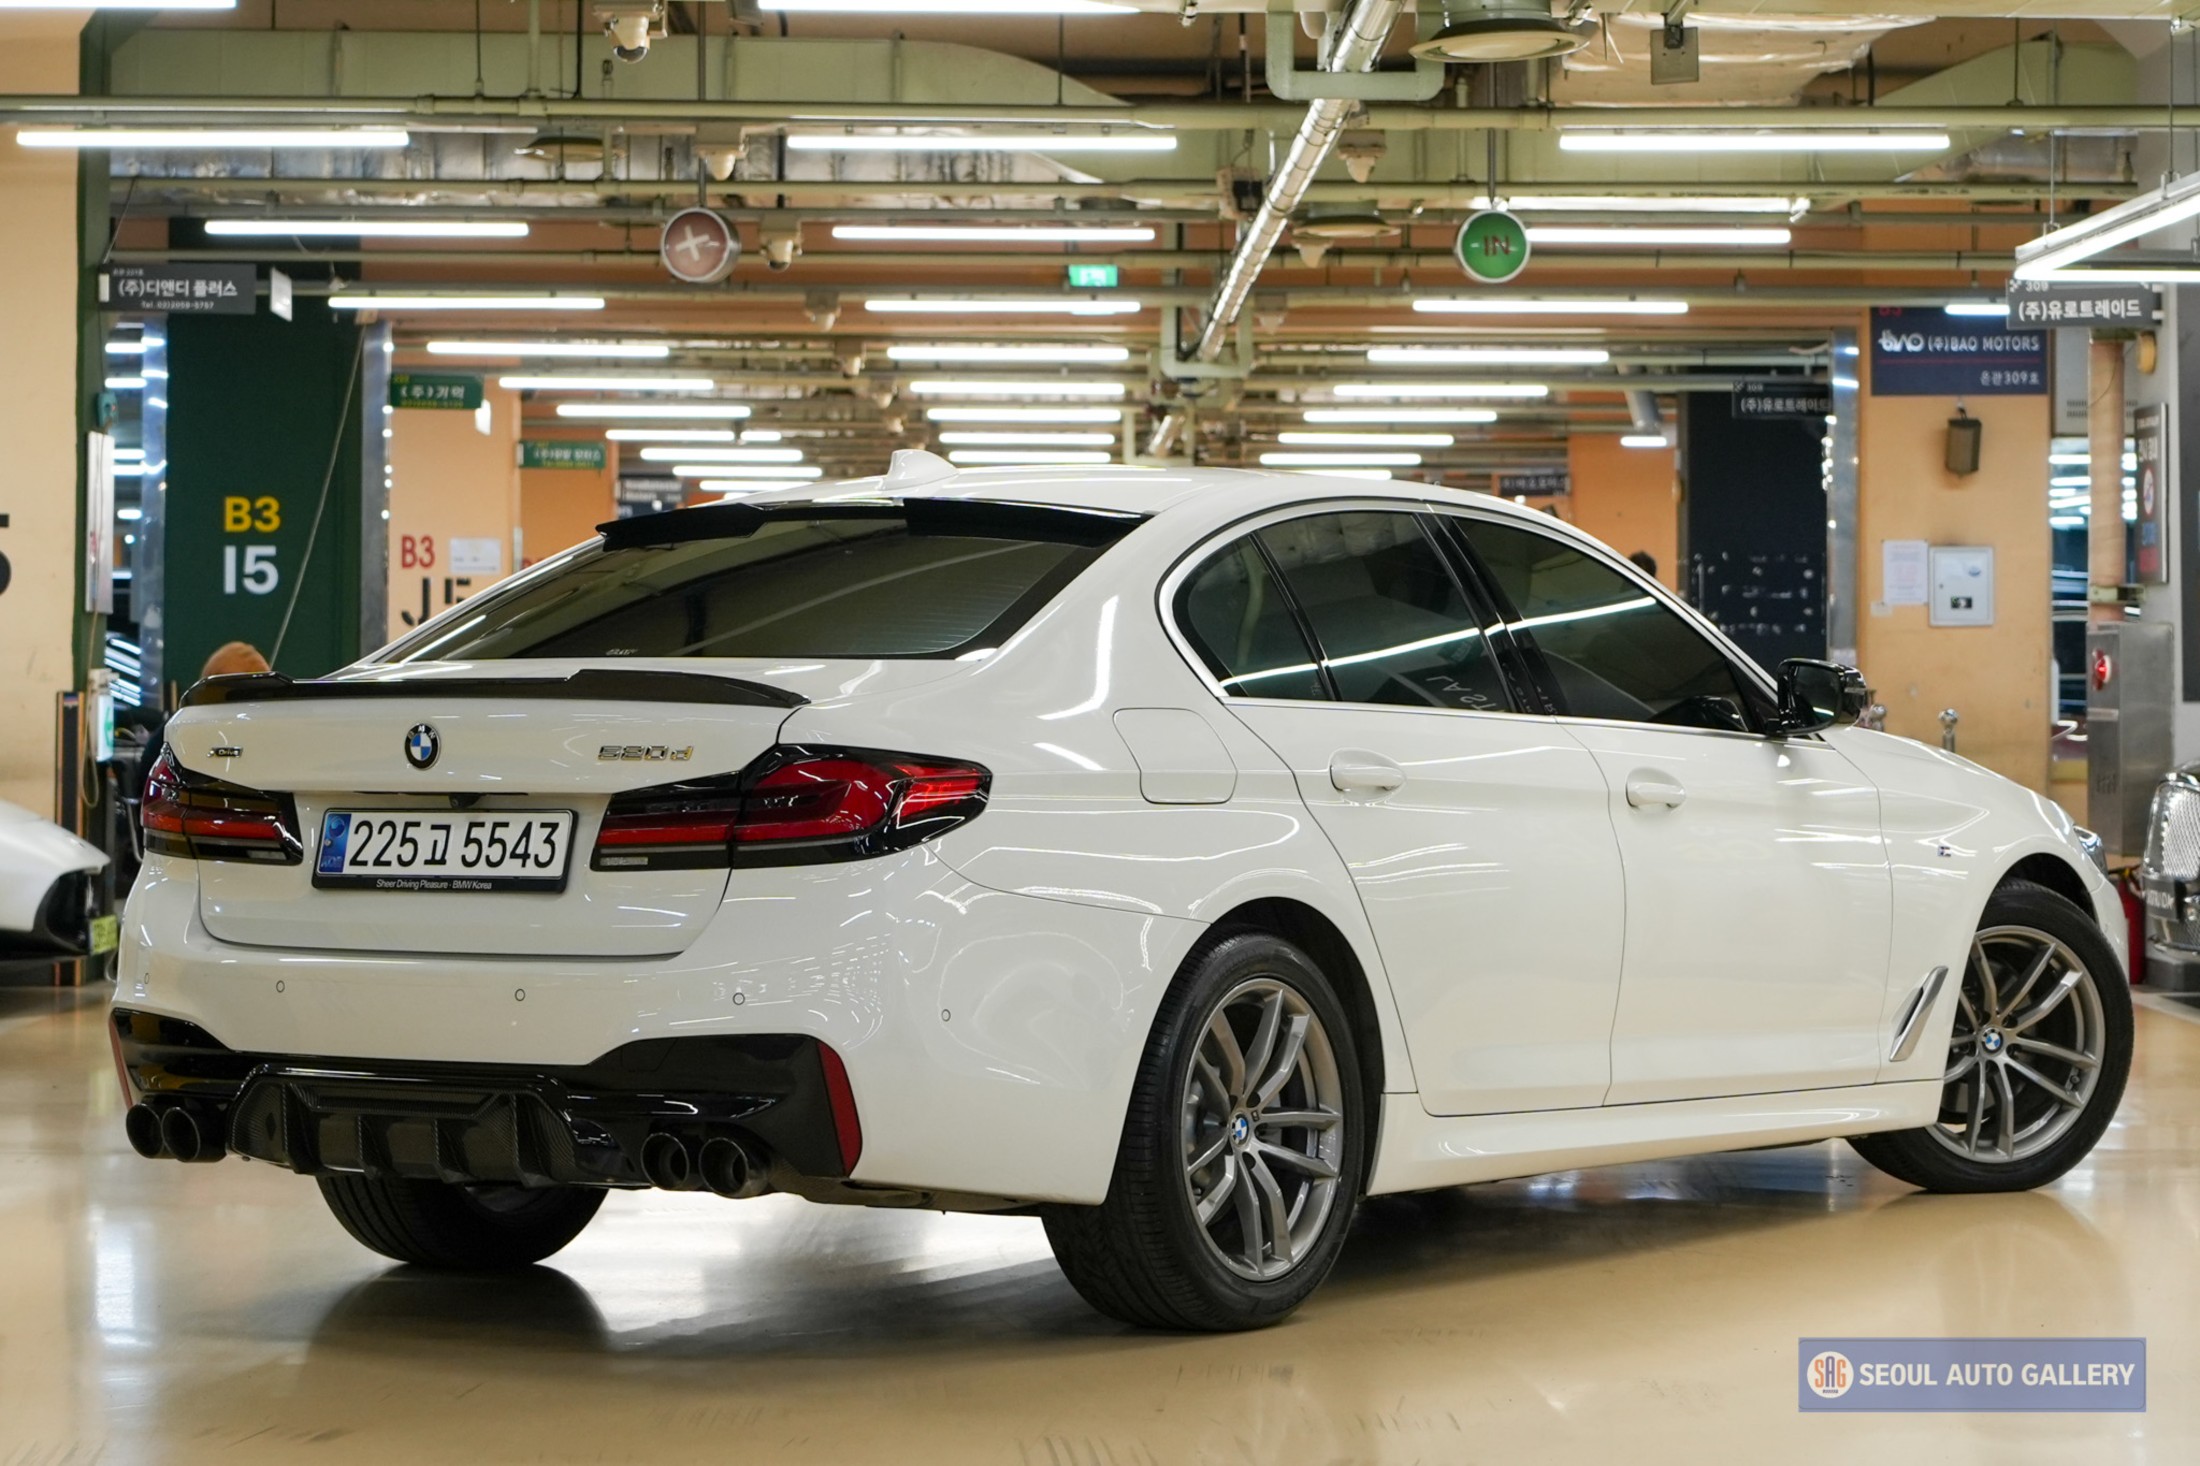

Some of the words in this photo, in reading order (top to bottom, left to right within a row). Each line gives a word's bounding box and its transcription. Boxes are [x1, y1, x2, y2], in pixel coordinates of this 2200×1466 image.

[118, 279, 190, 298] (주)디앤디
[193, 280, 238, 297] 플러스
[2018, 299, 2142, 321] (주)유로트레이드
[1982, 336, 2040, 351] MOTORS
[224, 495, 281, 533] B3
[401, 534, 435, 569] B3
[461, 821, 560, 868] 5543
[376, 879, 396, 888] Sheer
[396, 879, 419, 890] Driving
[420, 880, 448, 889] Pleasure
[452, 880, 472, 889] BMW
[472, 881, 492, 889] Korea
